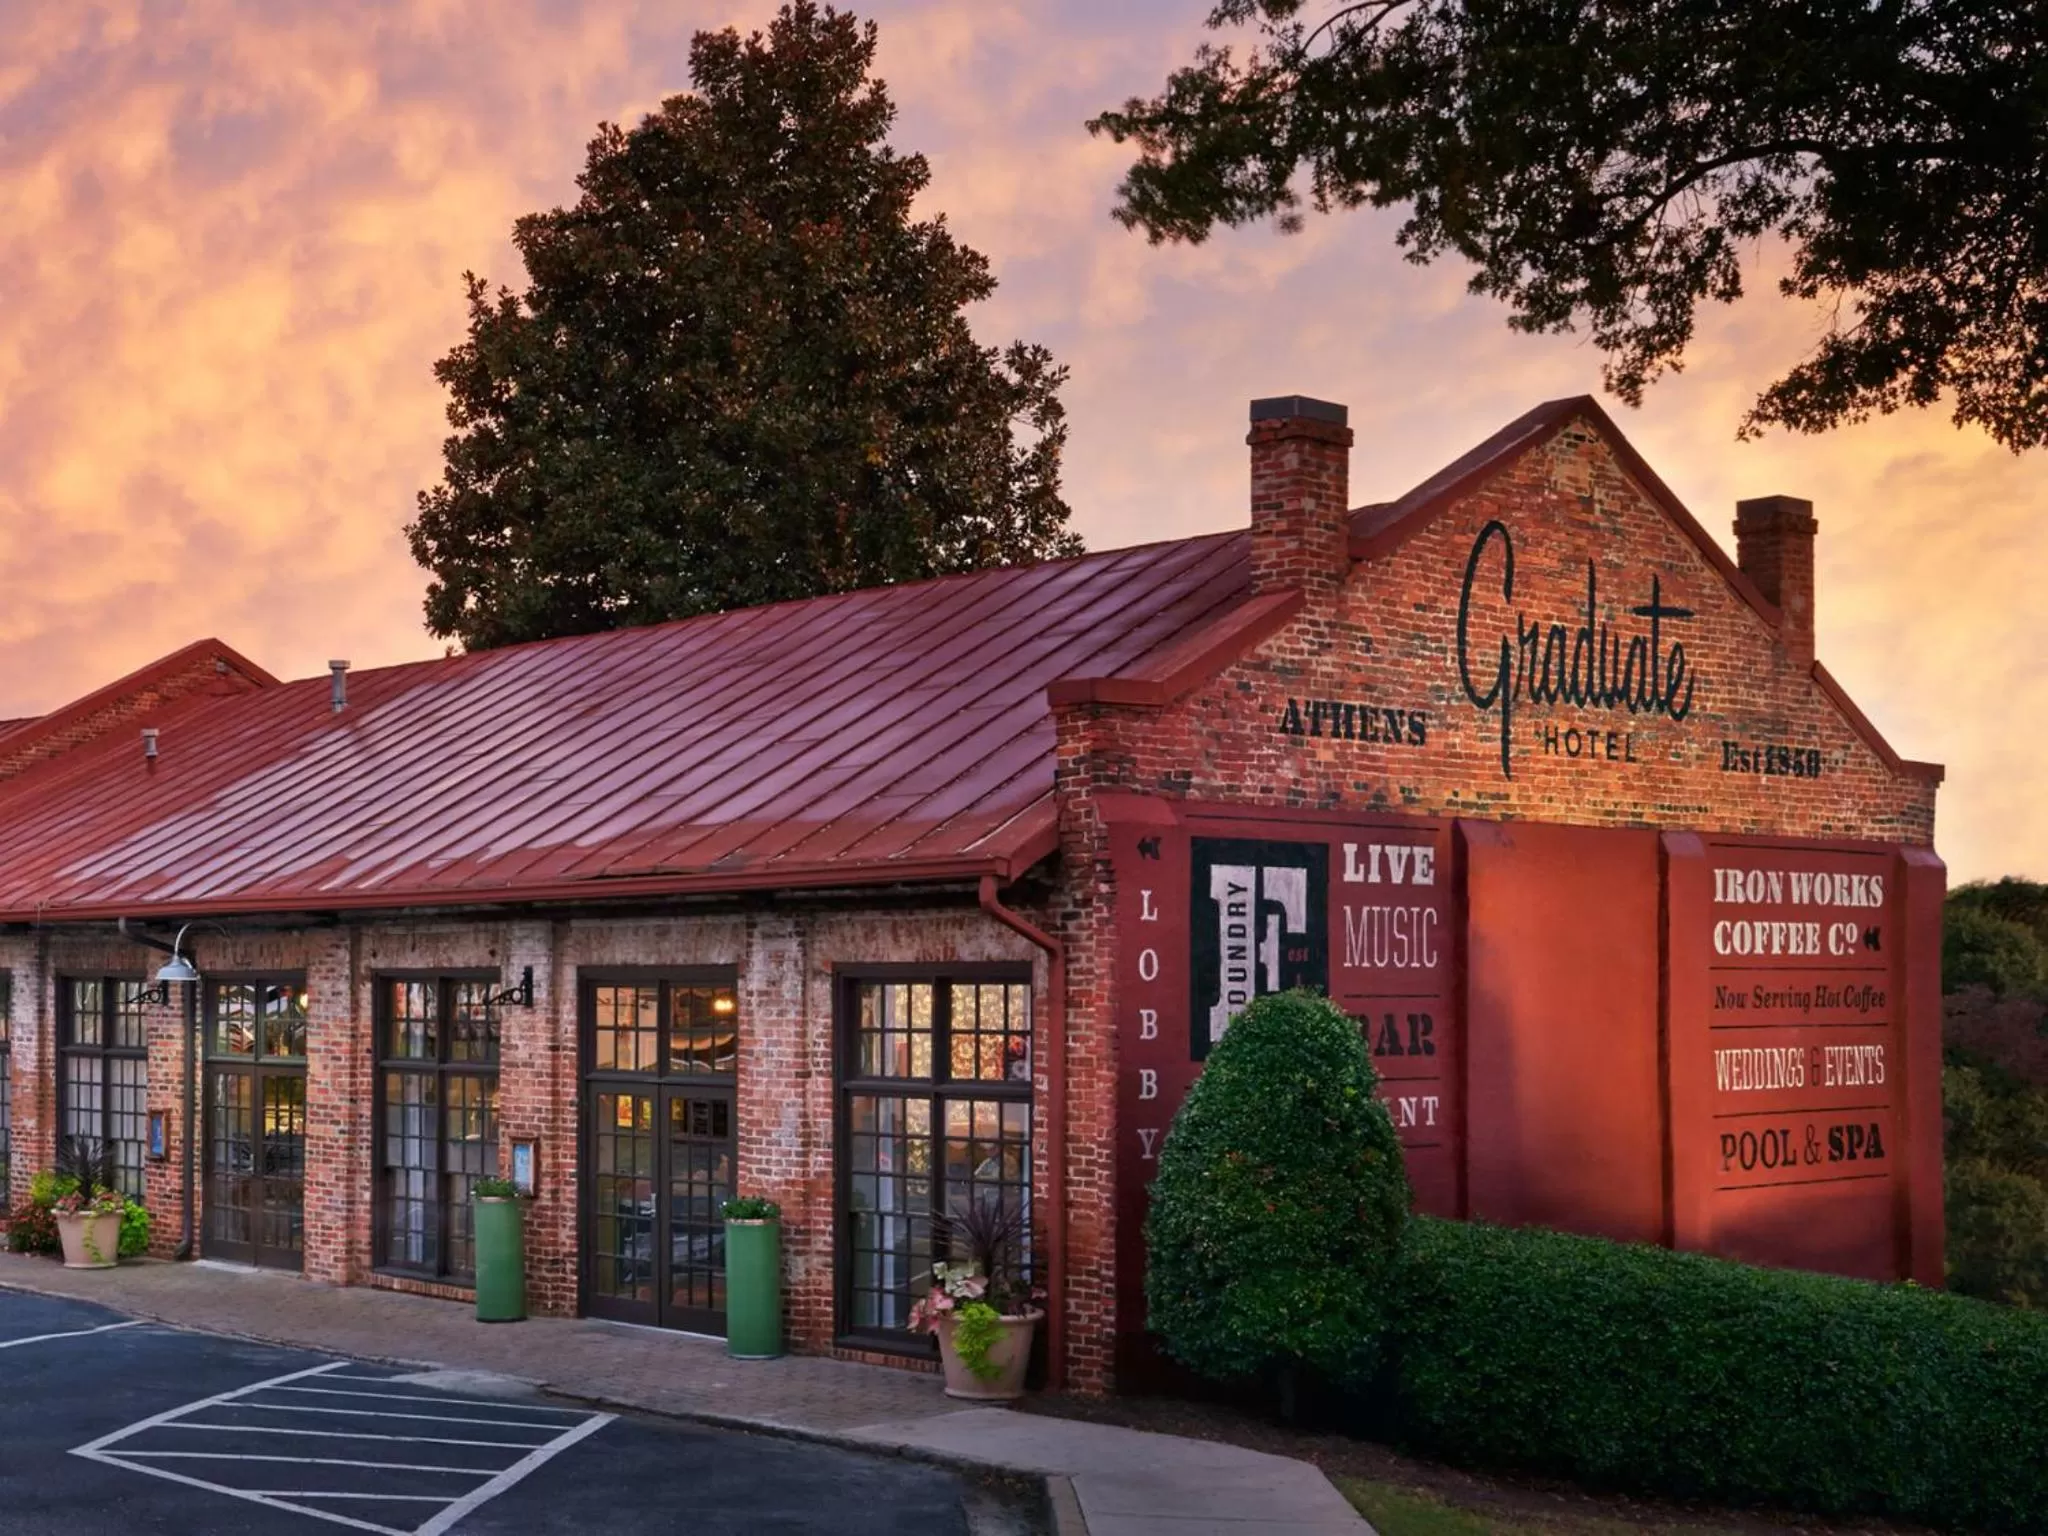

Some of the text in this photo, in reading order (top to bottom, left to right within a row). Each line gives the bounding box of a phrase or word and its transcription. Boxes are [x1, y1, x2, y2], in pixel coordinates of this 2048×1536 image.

[1457, 520, 1695, 781] Graduate
[1279, 699, 1427, 746] ATHENS
[1544, 725, 1638, 763] HOTEL
[1343, 843, 1435, 885] LIVE
[1713, 868, 1884, 907] IRON WORKS
[1227, 881, 1249, 1017] OUNDRY
[1343, 905, 1438, 969] MUSIC
[1713, 920, 1821, 955] COFFEE
[1714, 984, 1886, 1014] Now Serving Hot Coffee
[1714, 1047, 1805, 1091] WEDDINGS
[1824, 1044, 1885, 1087] EVENTS
[1720, 1122, 1885, 1172] POOL & SPA
